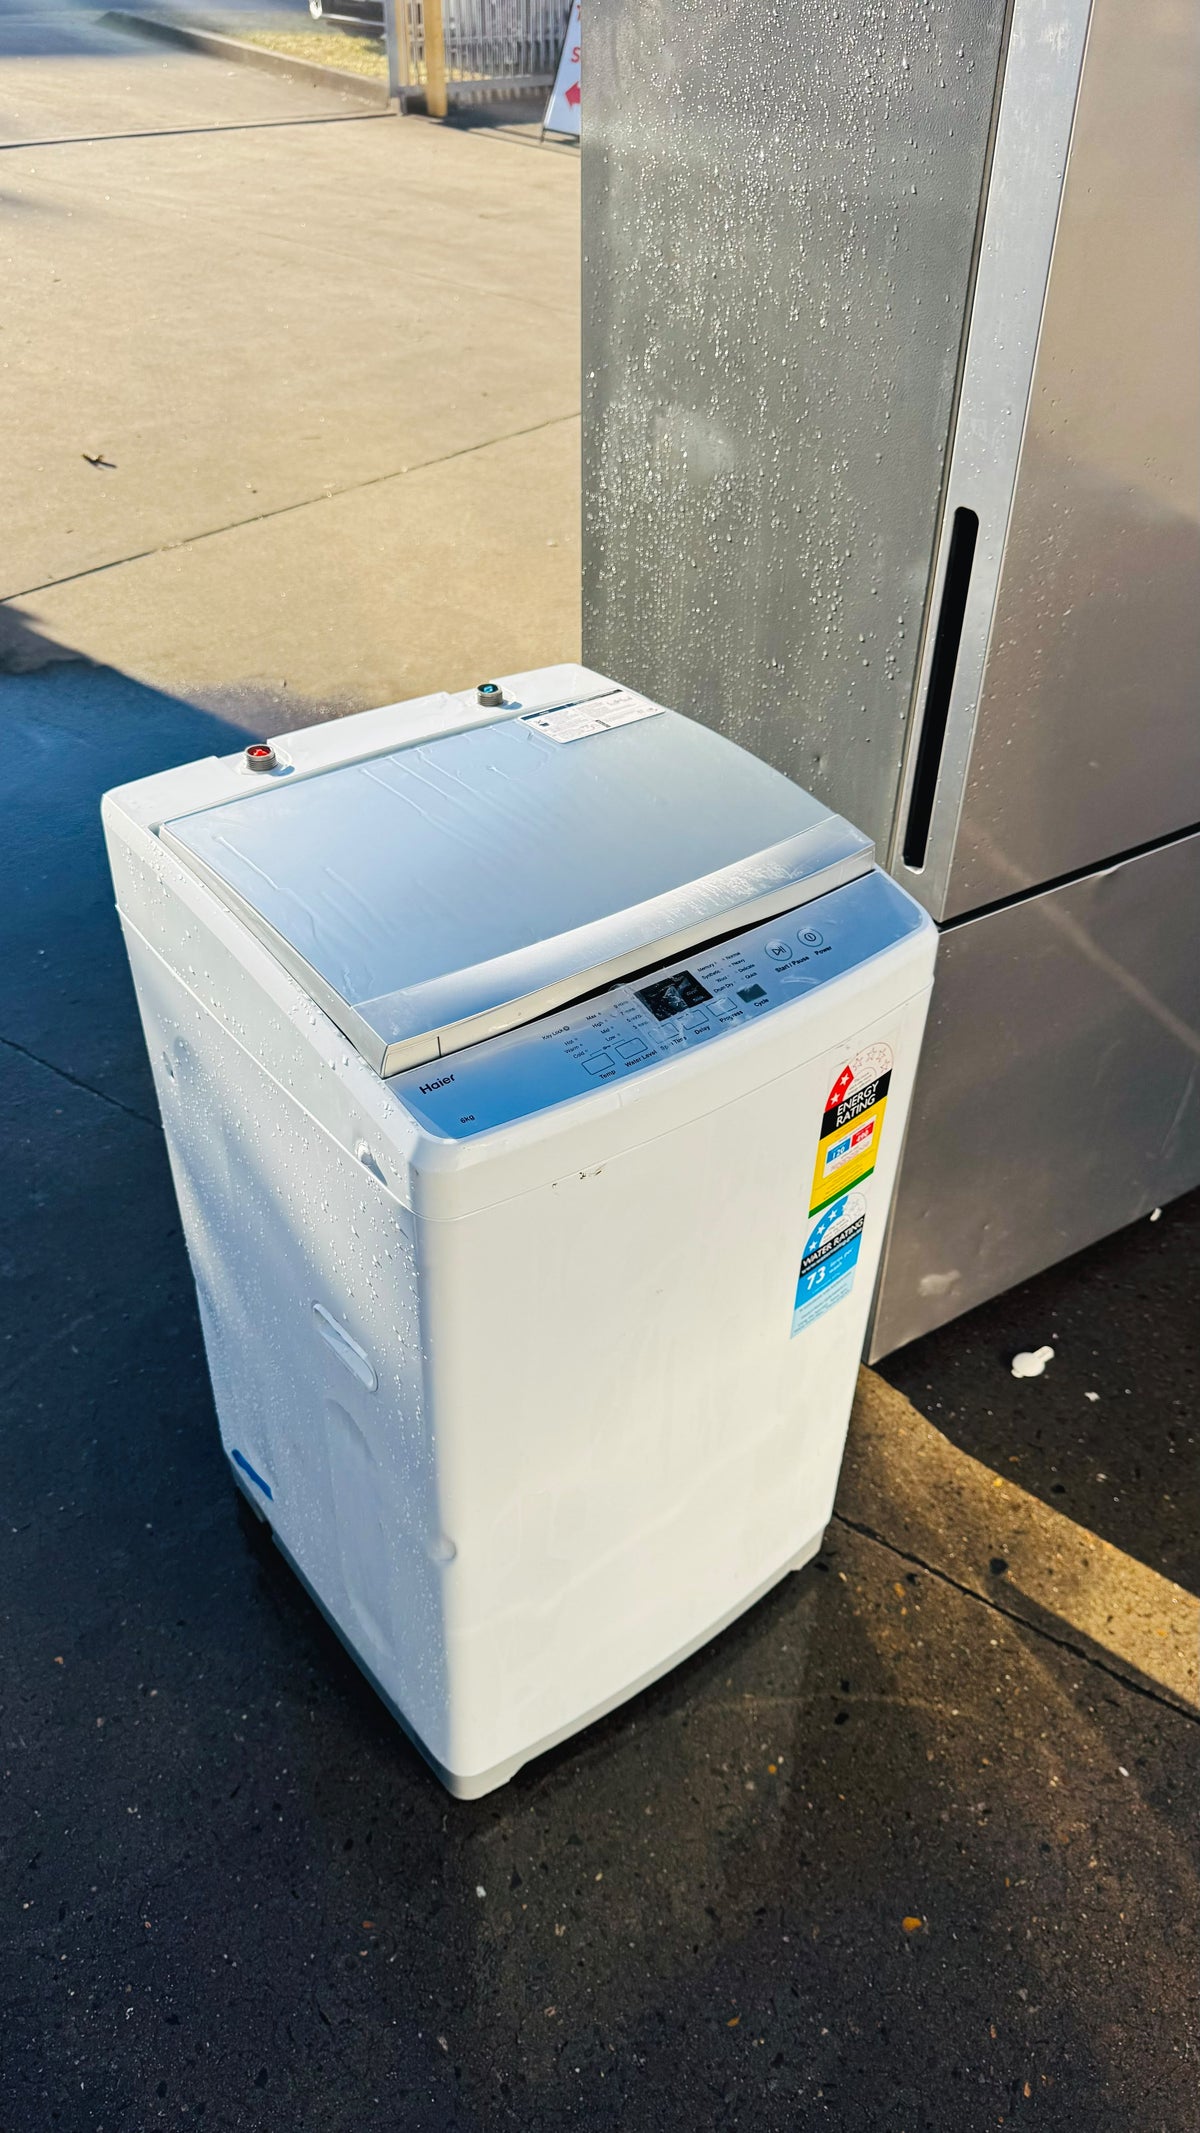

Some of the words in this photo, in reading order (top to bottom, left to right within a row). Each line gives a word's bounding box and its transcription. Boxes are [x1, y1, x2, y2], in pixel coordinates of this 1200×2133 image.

[814, 945, 832, 956] Power
[738, 963, 756, 974] Delicate
[775, 963, 789, 973] Start
[792, 956, 810, 967] Pause
[745, 972, 758, 980] Quick
[754, 998, 770, 1007] Cycle
[720, 1010, 743, 1024] Progress
[694, 1025, 711, 1035] Delay
[542, 1033, 552, 1041] Key
[605, 1034, 616, 1042] Low
[564, 1045, 579, 1054] Warm
[573, 1051, 585, 1059] Cold
[625, 1057, 641, 1067] Water
[641, 1050, 657, 1059] Level
[599, 1070, 616, 1080] Temp
[419, 1074, 455, 1094] Haier
[837, 1080, 879, 1116] ENERGY
[836, 1094, 876, 1127] RATING
[460, 1114, 475, 1123] 6kg
[832, 1146, 846, 1160] 120
[833, 1217, 864, 1246] RATING
[803, 1242, 833, 1267] WATER
[807, 1266, 826, 1290] 73
